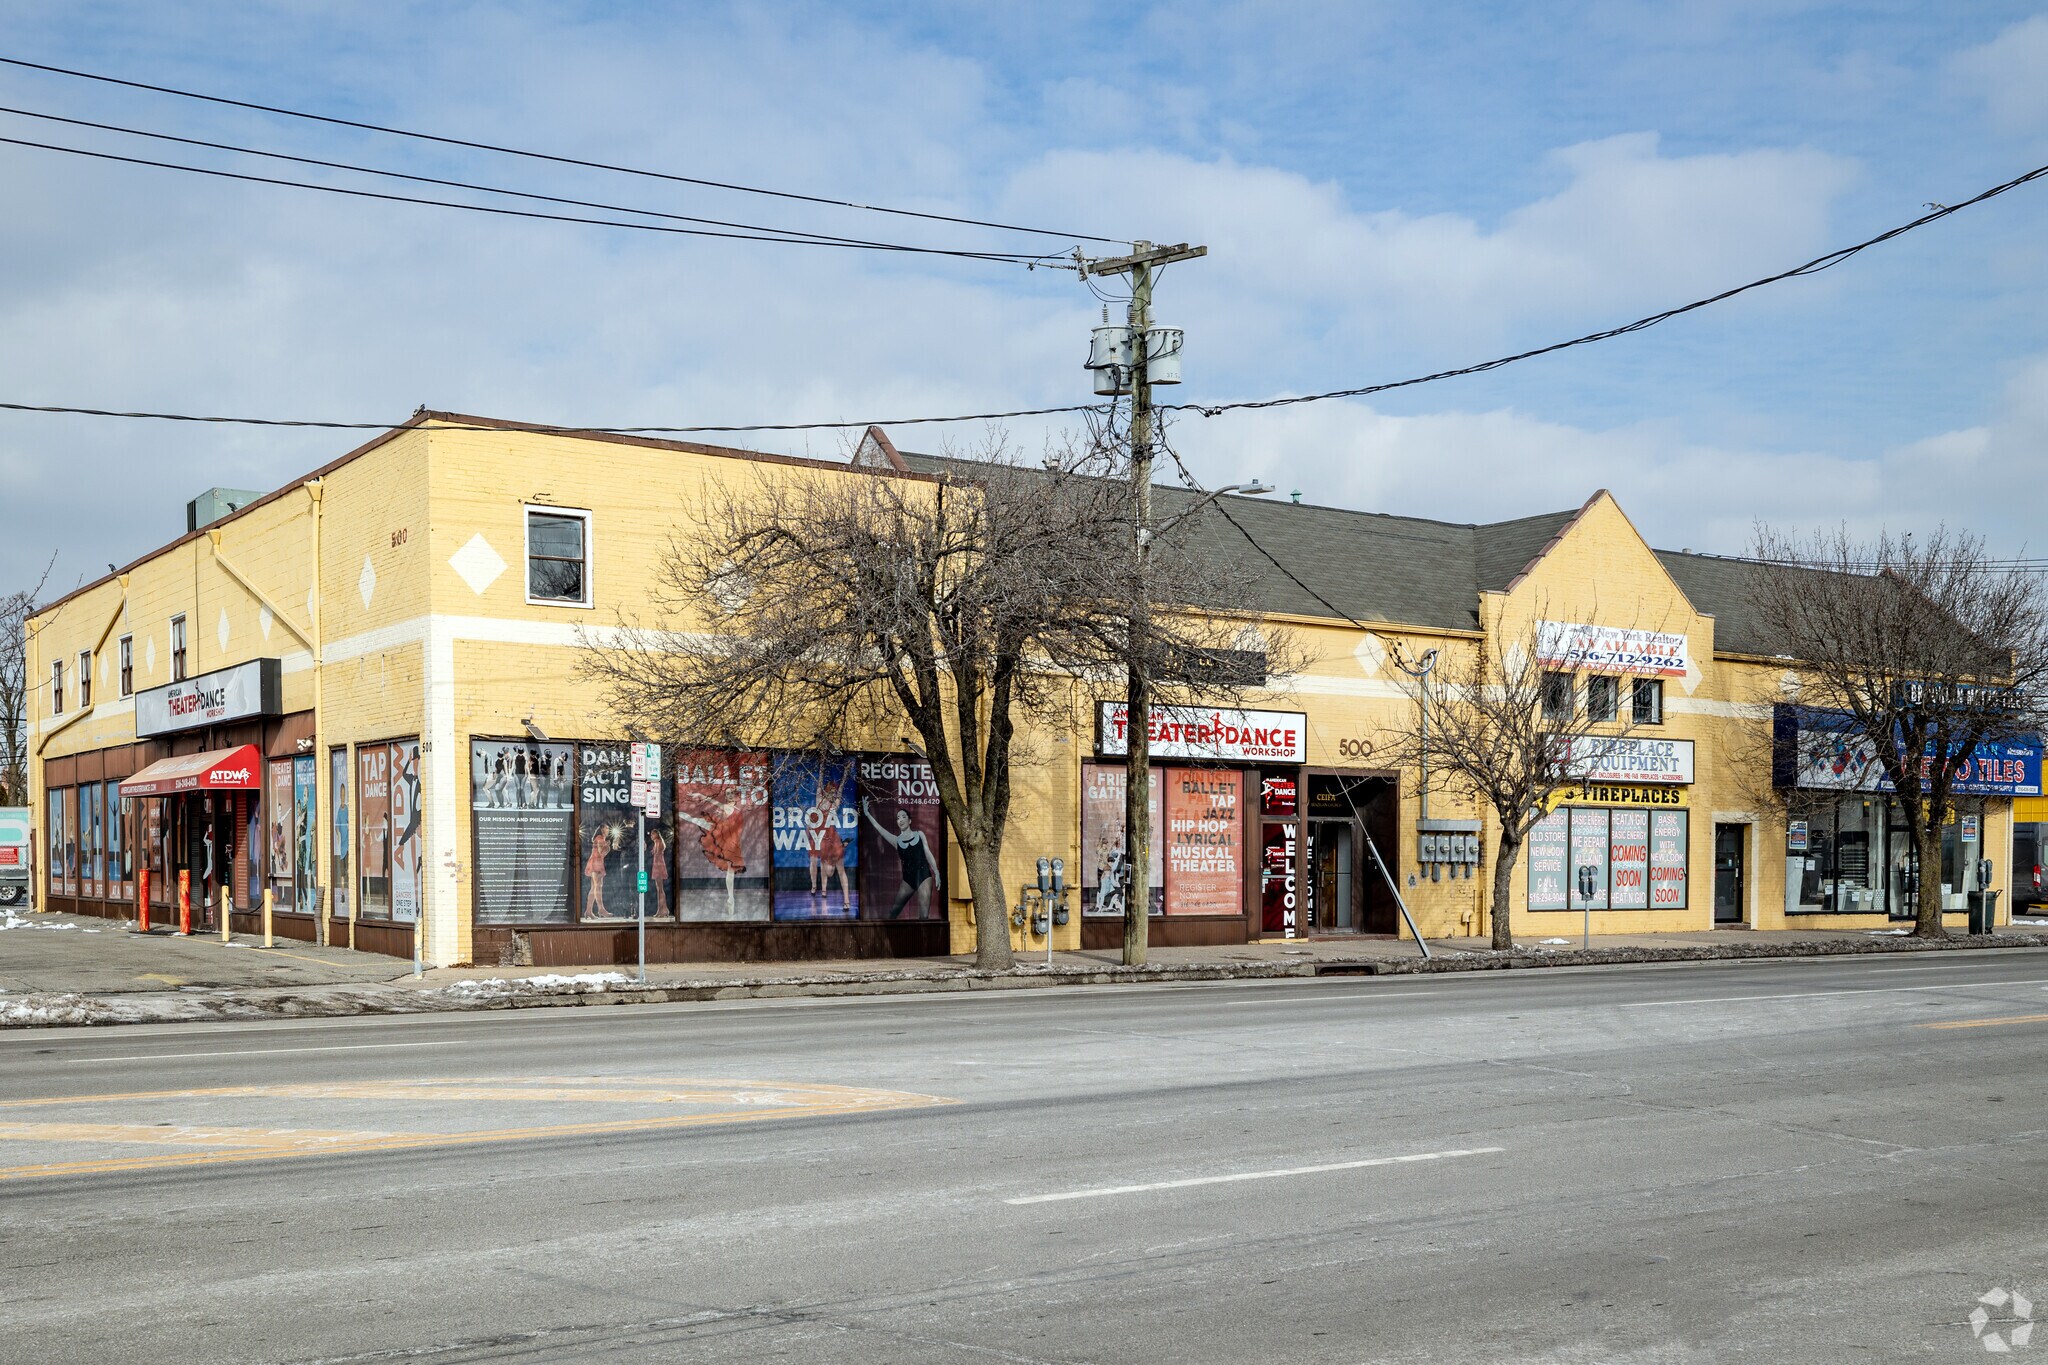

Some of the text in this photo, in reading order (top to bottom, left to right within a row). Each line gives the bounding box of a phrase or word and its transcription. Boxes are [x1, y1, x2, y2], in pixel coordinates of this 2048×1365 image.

[1597, 627, 1617, 639] New
[1621, 629, 1642, 642] York
[1574, 637, 1680, 657] AVAILABLE
[1570, 649, 1684, 668] 516-712-9262
[168, 688, 225, 717] THEATER DANCE
[206, 707, 225, 718] WORKSHOP
[1113, 709, 1163, 721] AMAN
[1113, 720, 1296, 748] TEATER DANCE
[422, 742, 432, 753] 500
[1242, 747, 1296, 757] WORKSHOP
[1339, 739, 1373, 757] 500
[1590, 738, 1674, 757] FIREPLACE
[363, 752, 387, 782] TAP
[1590, 755, 1680, 772] EQUIPMENT
[1977, 758, 2025, 783] TILES
[210, 770, 241, 780] ATDW
[583, 769, 626, 785] ACT.
[677, 764, 768, 785] BALLET
[1098, 773, 1156, 787] FRIES
[365, 782, 387, 798] DANCE
[736, 785, 768, 806] TO
[898, 780, 940, 797] NOW
[1182, 782, 1236, 795] BALLET
[1274, 788, 1296, 796] DANCE
[1583, 786, 1680, 804] FIREPLACES
[1210, 794, 1236, 808] TAP
[1316, 793, 1336, 802] CEIFA
[773, 807, 859, 829] BROAD
[1203, 808, 1235, 820] JAZZ
[1571, 814, 1608, 826] BASIC ENERGY
[1658, 815, 1677, 825] BASIC
[1171, 820, 1228, 833] HIP HOP
[1654, 827, 1681, 837] ENERGY
[773, 829, 826, 851] WAY
[1177, 833, 1235, 846] LYRICAL
[1529, 831, 1566, 842] OLD STORE
[1571, 836, 1606, 848] WE REPAIR
[1611, 830, 1646, 840] BASIC ENERGY
[1530, 846, 1565, 857] NEW LOOK
[1659, 840, 1676, 849] WITH
[1171, 846, 1234, 860] MUSICAL
[1574, 854, 1588, 865] ALL
[1611, 845, 1647, 862] COMING
[1650, 852, 1684, 862] NEW LOOK
[1171, 859, 1236, 873] THEATER
[1534, 861, 1562, 872] SERVICE
[1616, 869, 1642, 887] SOON
[1650, 867, 1684, 881] COMING
[1180, 883, 1217, 892] REGISTER
[1570, 888, 1607, 900] FIRACE
[1655, 888, 1680, 903] SOON
